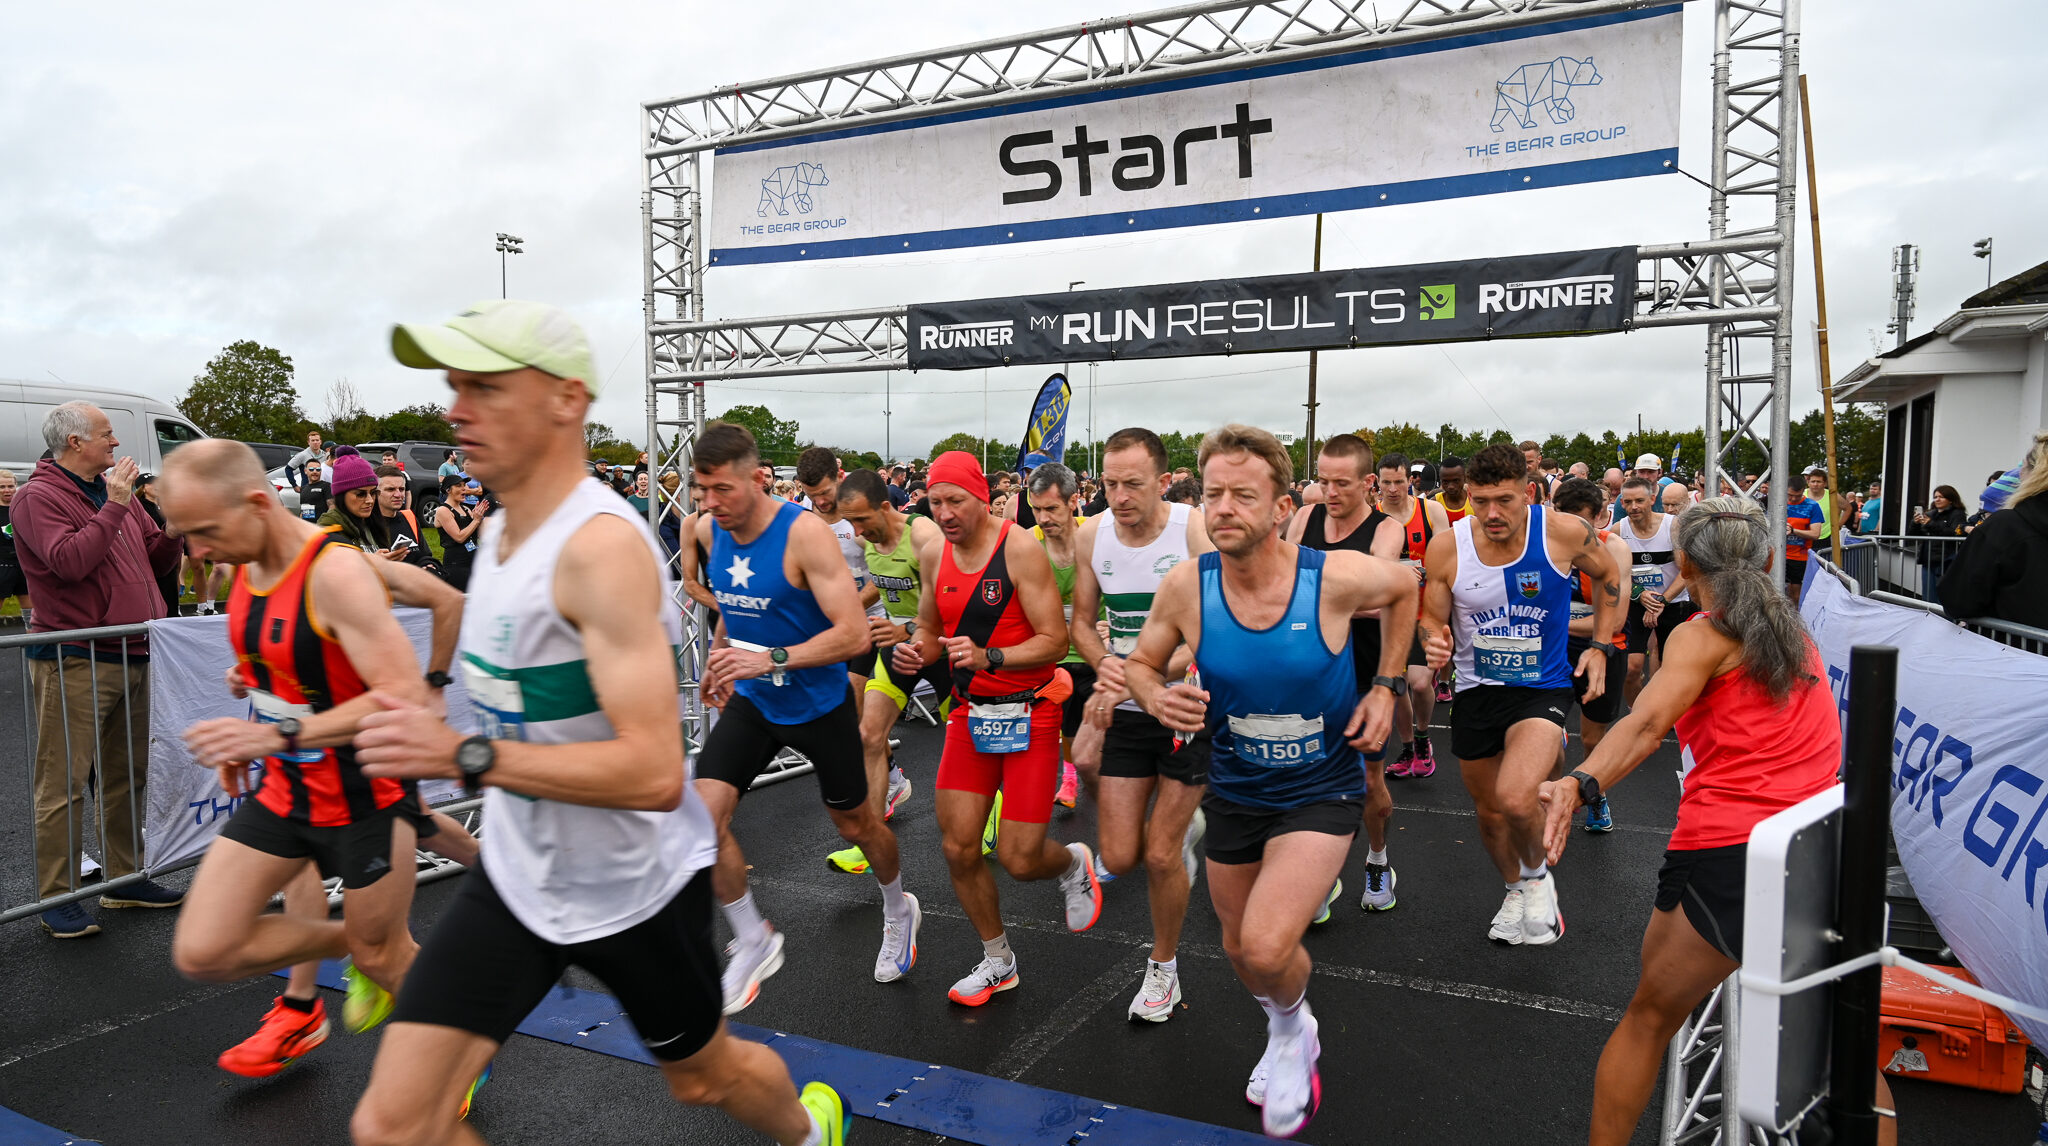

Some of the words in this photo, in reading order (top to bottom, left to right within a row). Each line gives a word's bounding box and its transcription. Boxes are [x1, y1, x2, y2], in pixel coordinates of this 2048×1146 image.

[1000, 102, 1272, 206] Start
[1466, 143, 1500, 158] THE
[1506, 136, 1554, 153] BEAR
[1560, 126, 1626, 146] GROUP
[740, 225, 764, 235] THE
[767, 222, 801, 234] BEAR
[804, 218, 847, 231] GROUP
[1478, 282, 1614, 314] RUNNER
[1030, 315, 1059, 331] MY
[1062, 307, 1155, 345] RUN
[1166, 288, 1406, 337] RESULTS
[920, 325, 1014, 350] RUNNER
[714, 590, 772, 610] SAYSKY
[1892, 705, 1974, 831] EAR
[189, 792, 249, 825] TH
